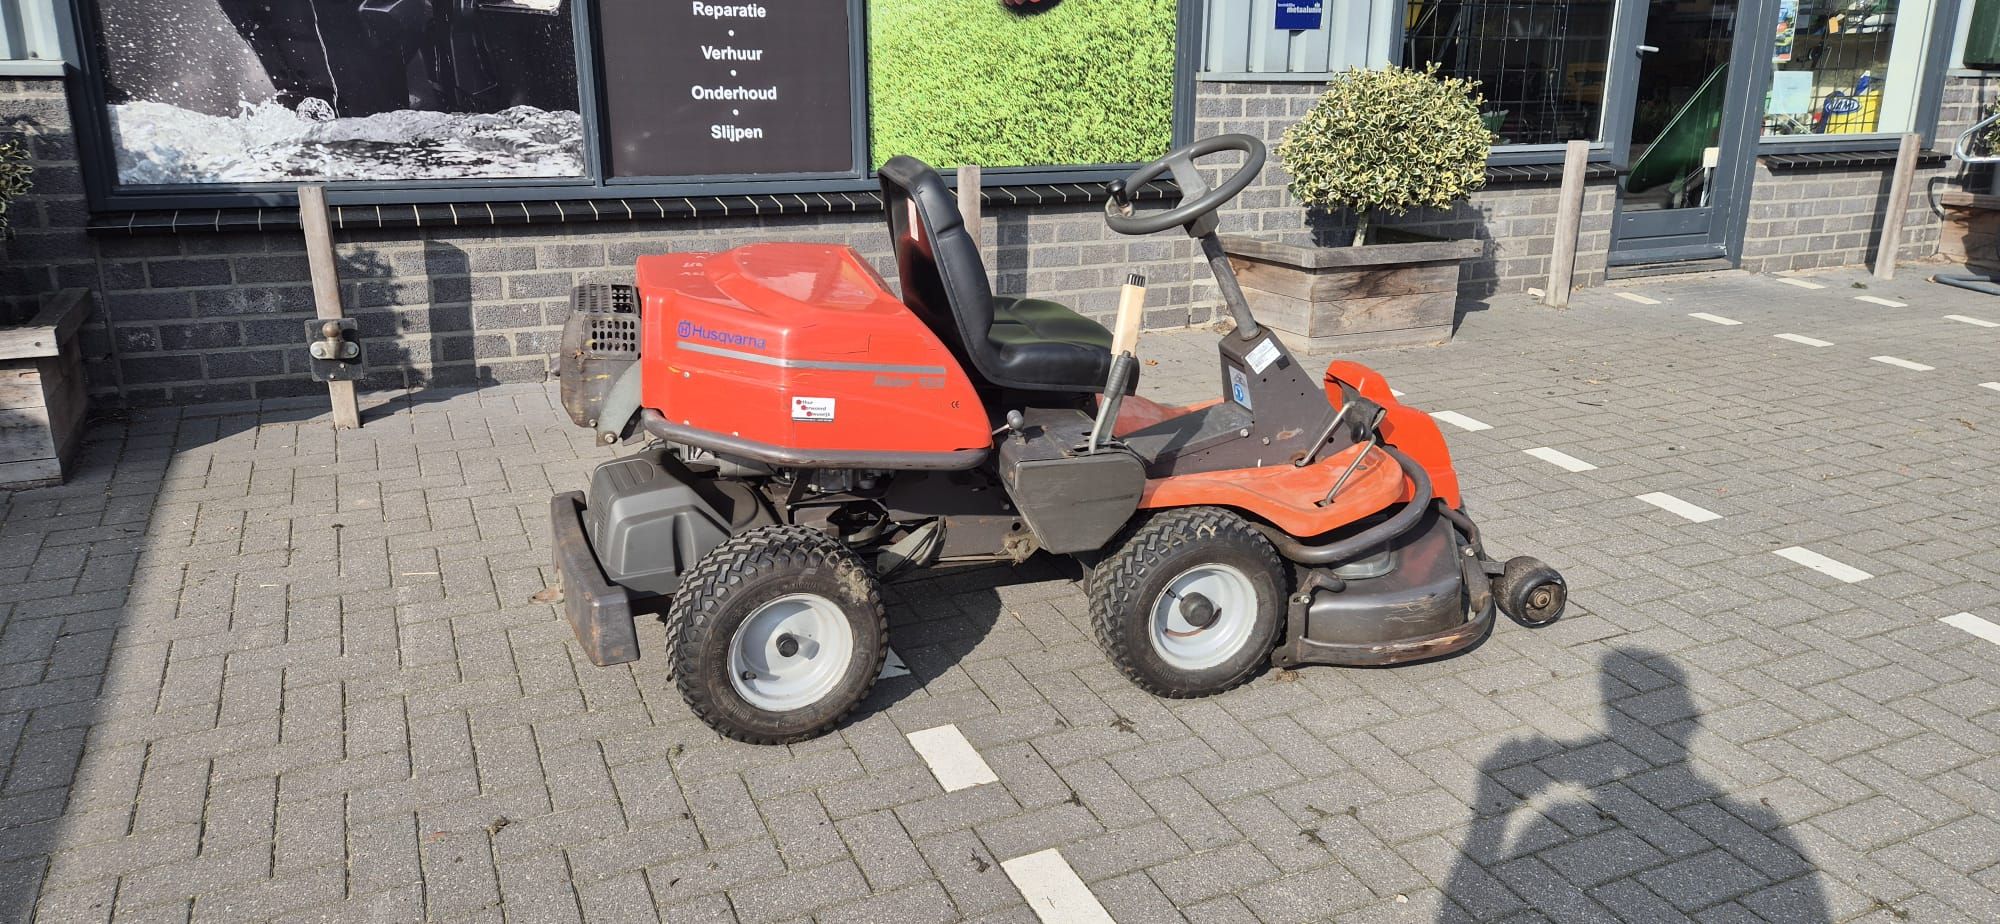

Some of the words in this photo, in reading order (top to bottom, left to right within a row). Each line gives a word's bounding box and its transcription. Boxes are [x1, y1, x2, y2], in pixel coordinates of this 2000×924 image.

[692, 1, 767, 20] Reparatie
[701, 45, 763, 61] Verhuur
[691, 85, 777, 100] Onderhoud
[711, 124, 763, 142] Slijpen
[692, 323, 767, 350] Husqvarna
